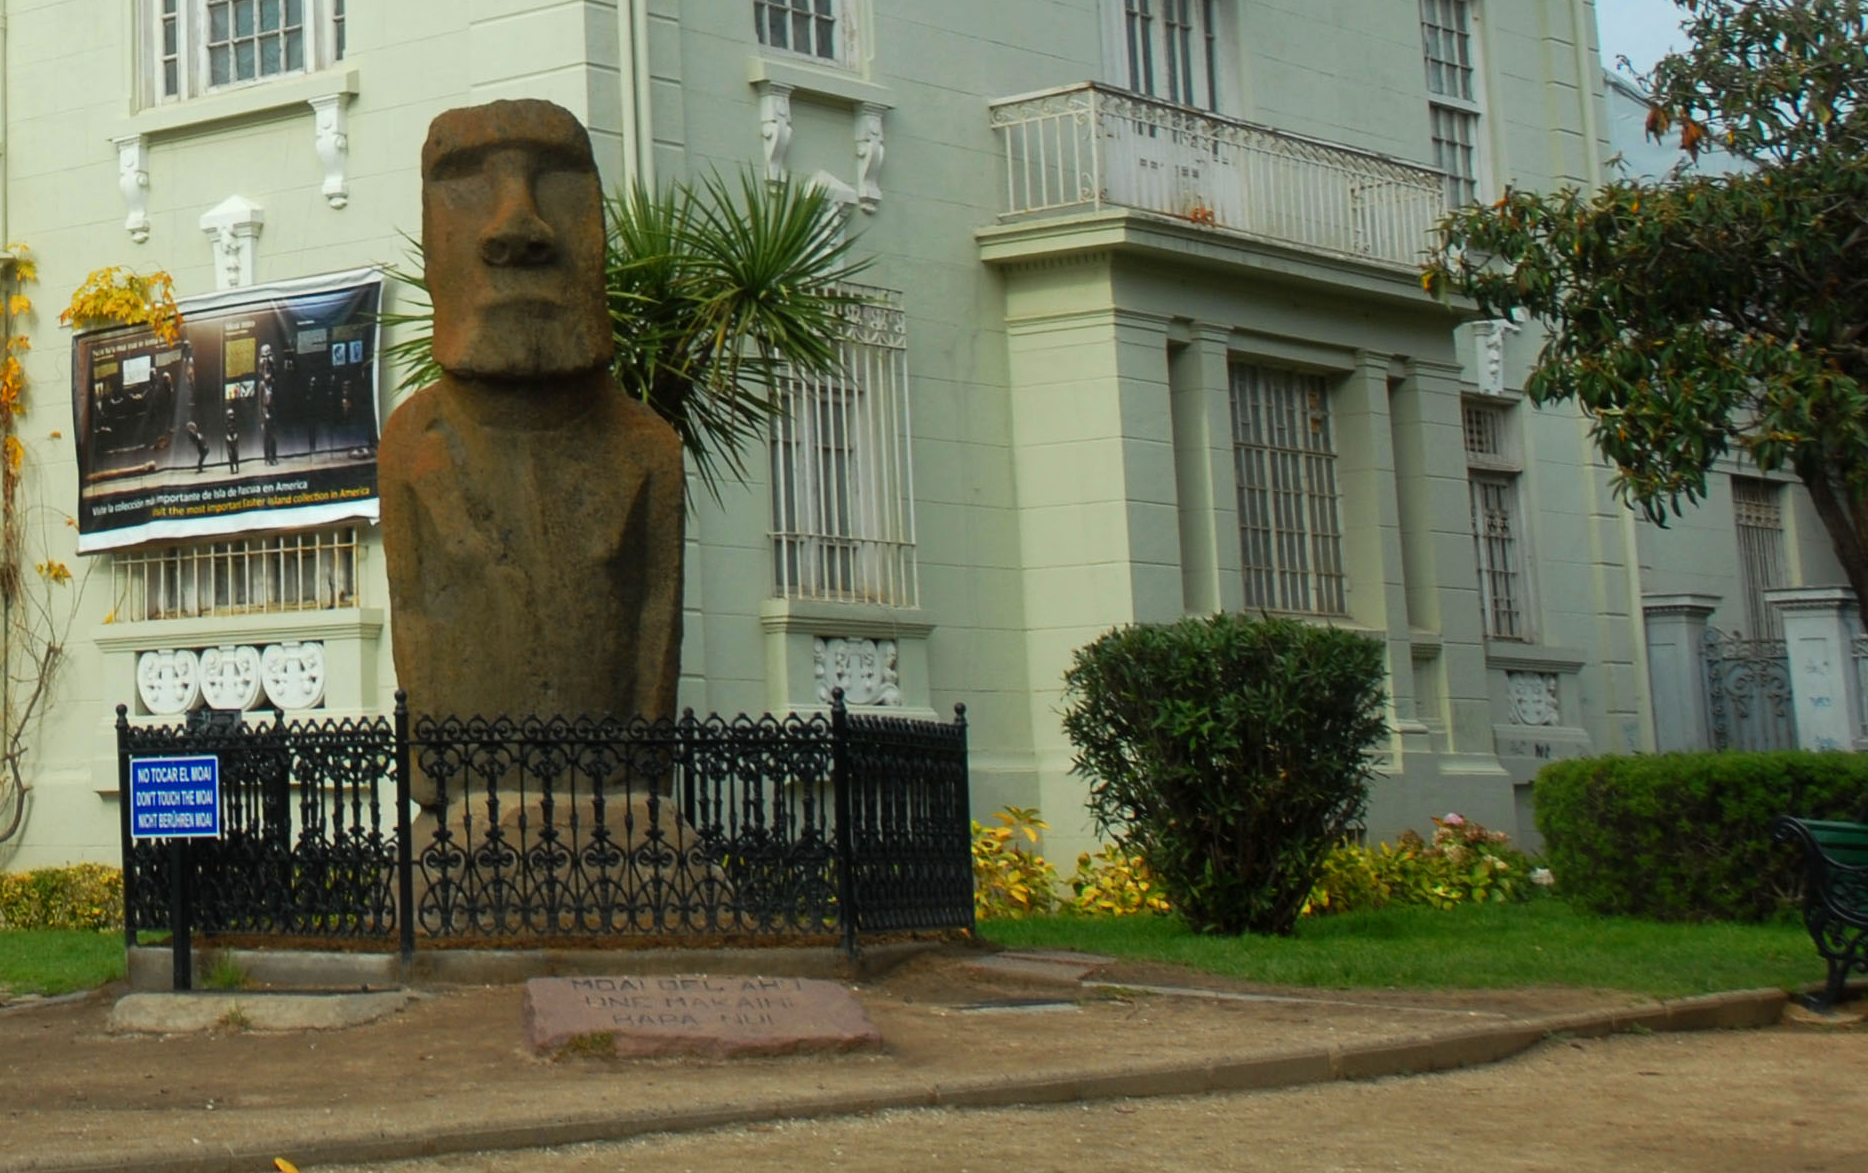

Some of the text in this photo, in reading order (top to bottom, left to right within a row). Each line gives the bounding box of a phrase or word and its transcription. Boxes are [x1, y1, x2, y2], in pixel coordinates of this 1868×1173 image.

[202, 490, 212, 500] de
[213, 488, 227, 499] Isla
[227, 487, 237, 497] de
[263, 484, 274, 493] en
[168, 505, 184, 515] the
[186, 505, 205, 514] most
[293, 491, 329, 503] collection
[330, 489, 338, 498] in
[137, 766, 212, 783] NO TOCAR EL MOAI
[136, 789, 213, 807] DON'T TOUCH THE MOAI
[138, 813, 157, 828] NICHT
[195, 812, 213, 828] MOAI
[571, 979, 645, 992] MOAI
